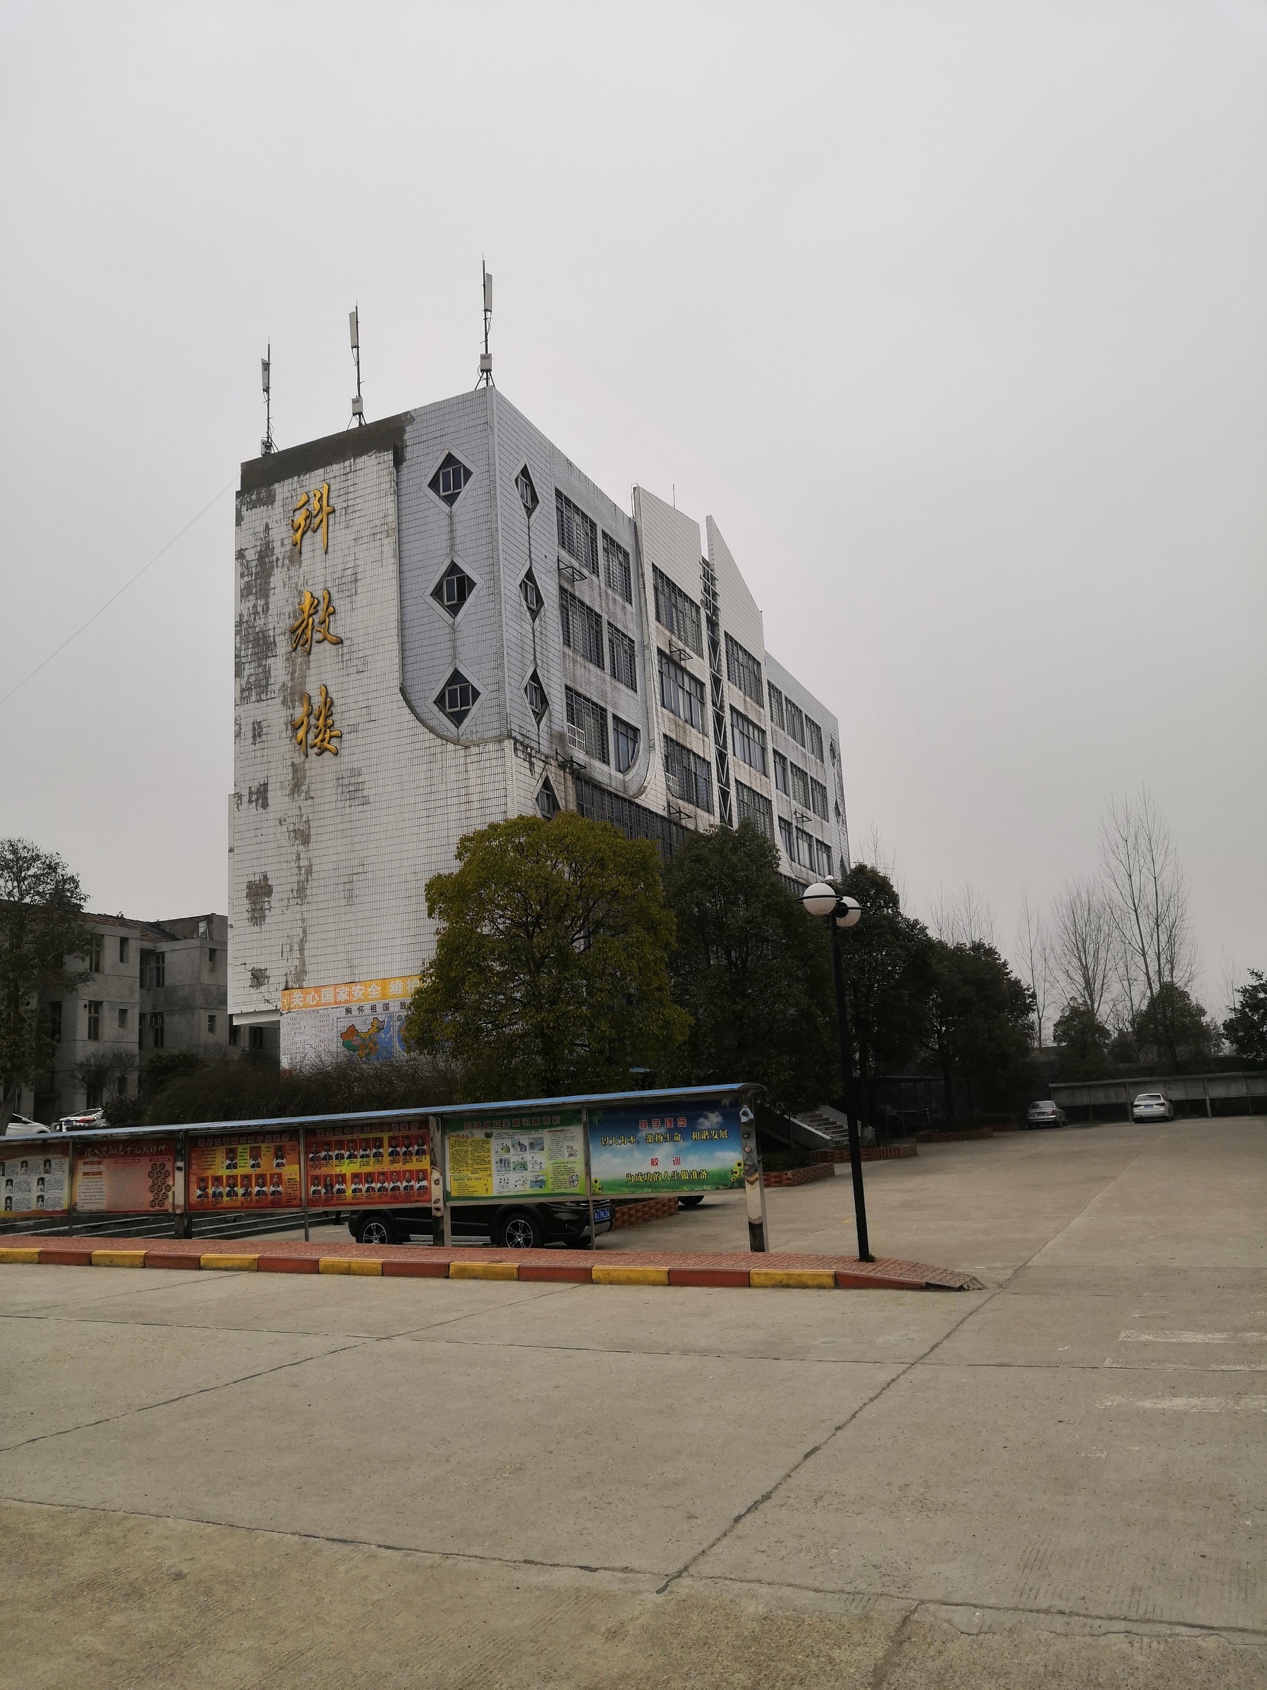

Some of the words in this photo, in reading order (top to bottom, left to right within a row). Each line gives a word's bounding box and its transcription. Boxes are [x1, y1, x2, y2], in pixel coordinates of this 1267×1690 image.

[289, 482, 343, 757] 科教楼
[291, 982, 382, 1007] 关心国家安全
[344, 1003, 390, 1016] 胸怀祖国
[638, 1116, 688, 1130] 办学理念
[691, 1128, 729, 1142] 和谐发展
[625, 1168, 709, 1183] 为成功的人生做准备
